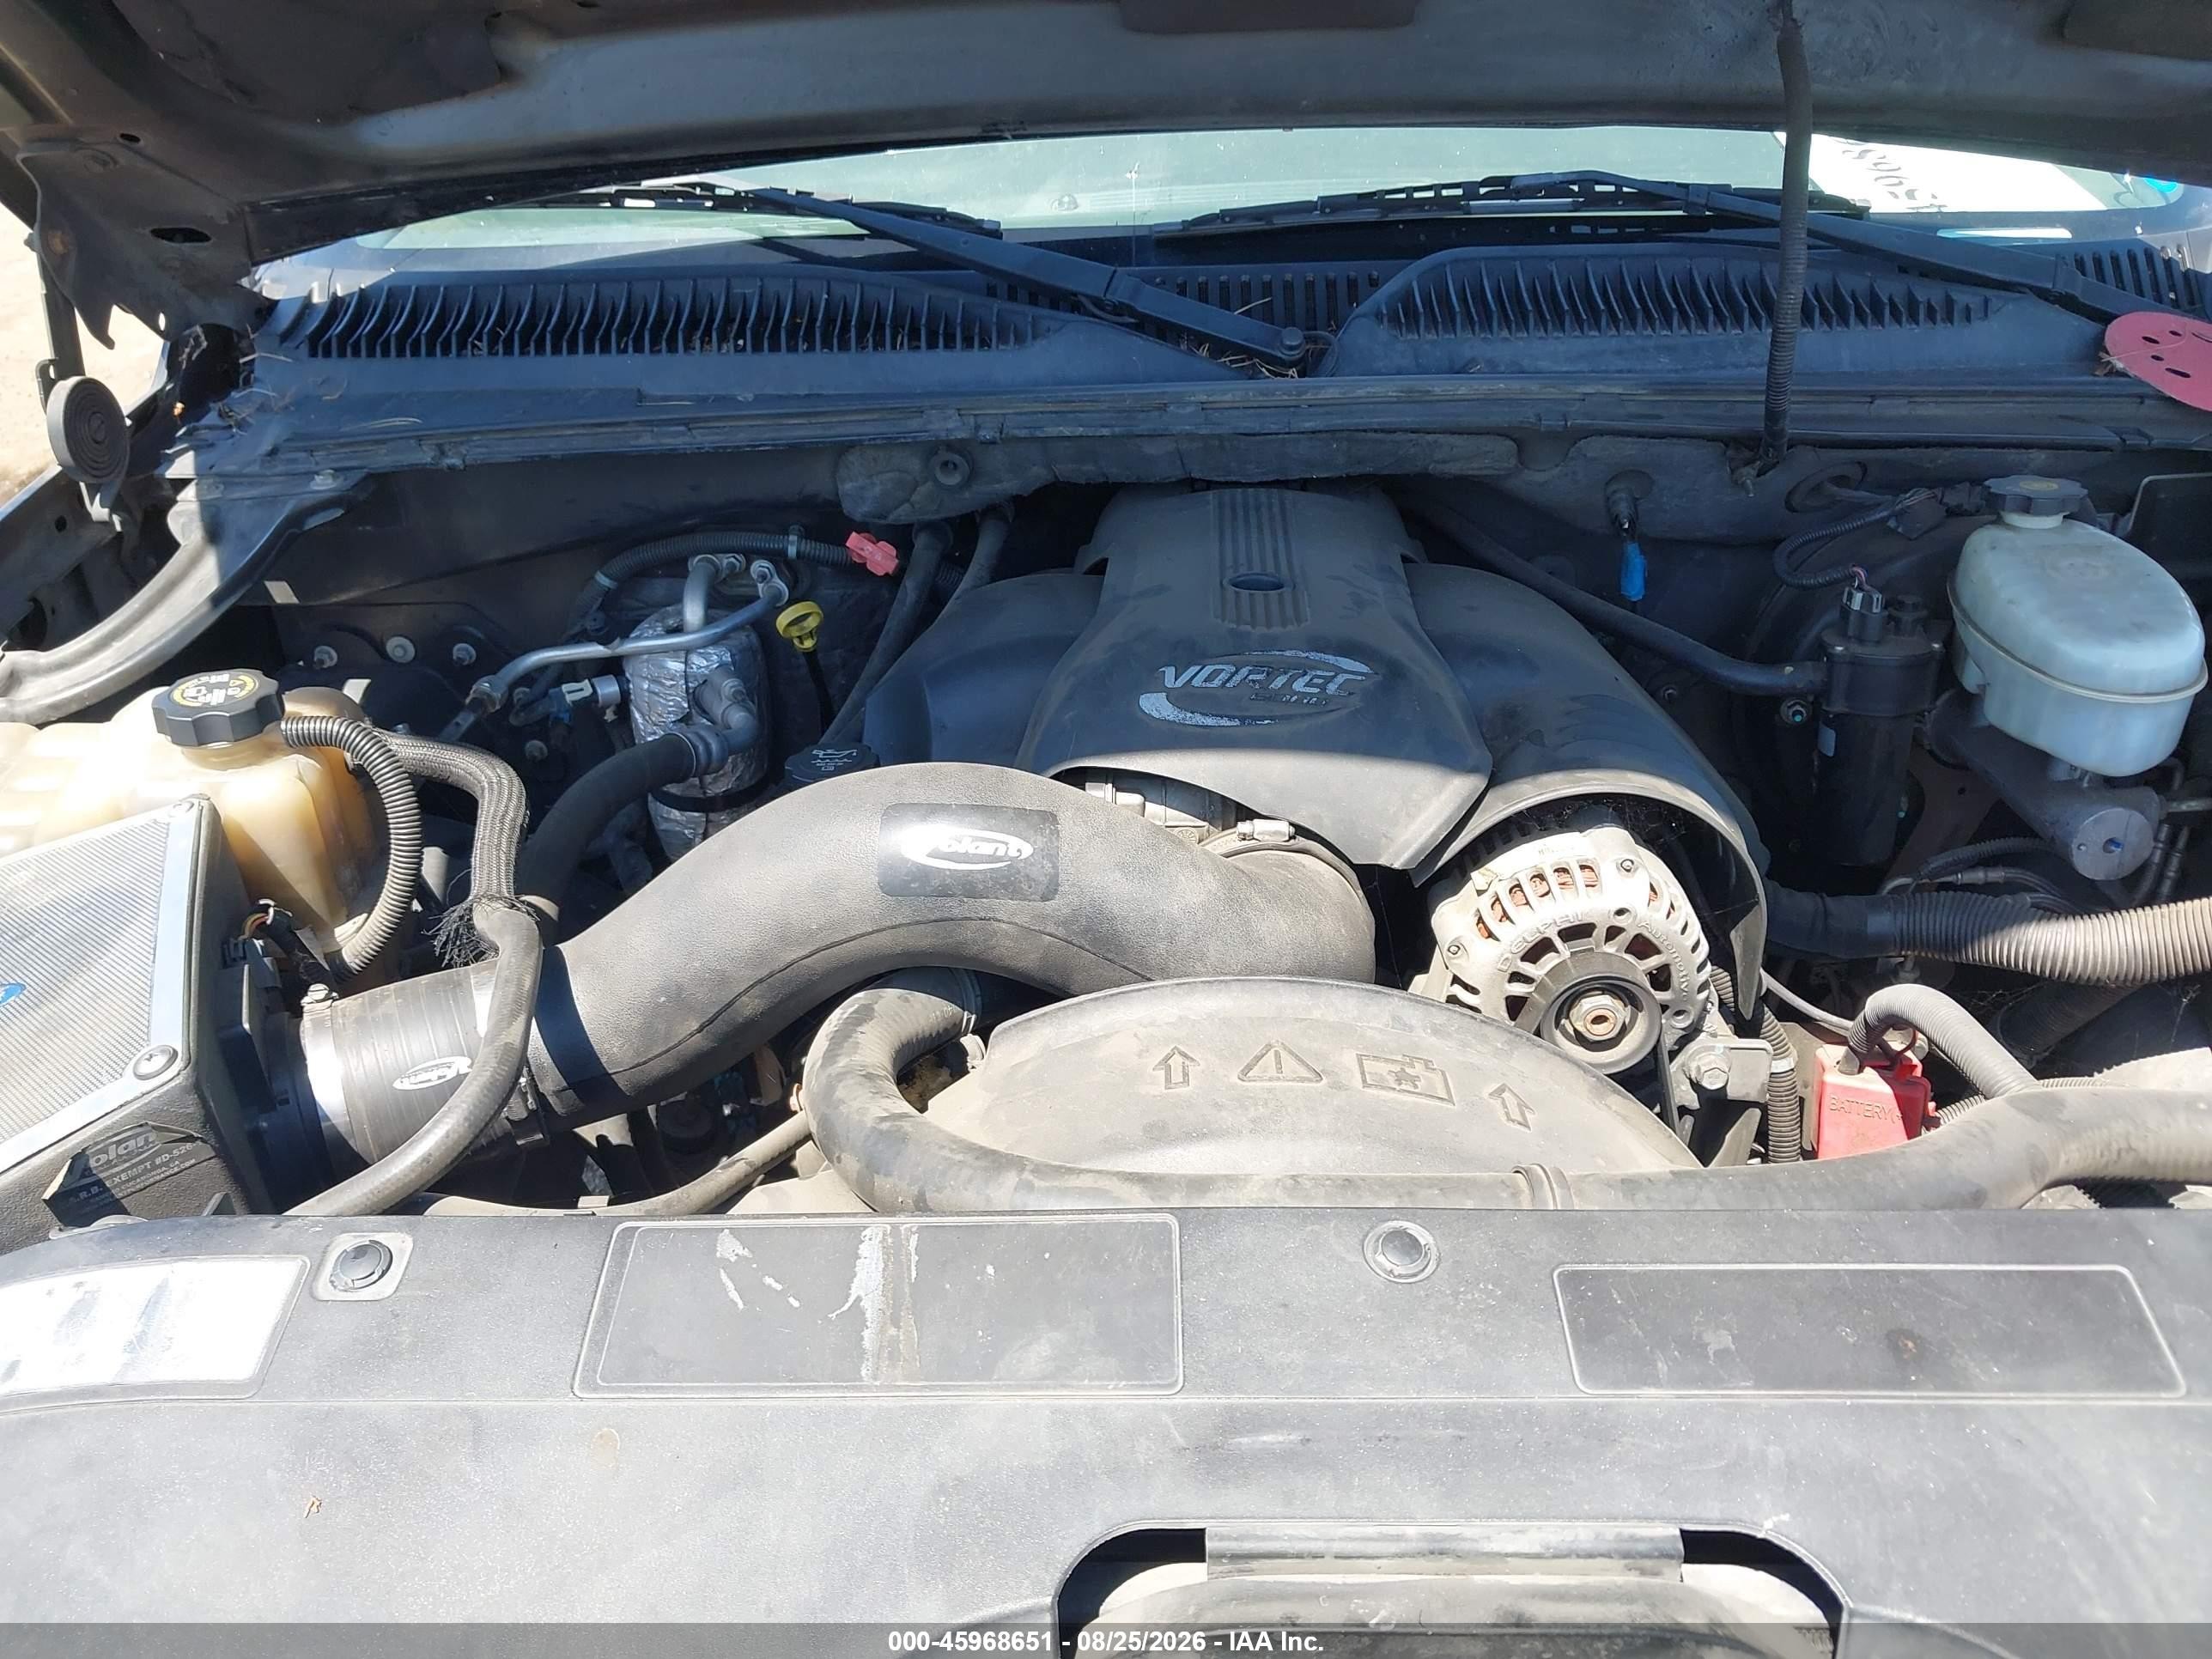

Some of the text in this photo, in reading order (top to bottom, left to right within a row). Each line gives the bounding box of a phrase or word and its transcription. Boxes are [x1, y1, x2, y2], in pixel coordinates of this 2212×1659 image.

[1159, 664, 1365, 696] VORTEC
[1497, 910, 1582, 972] DELPHI
[106, 1161, 152, 1187] EXEMPT
